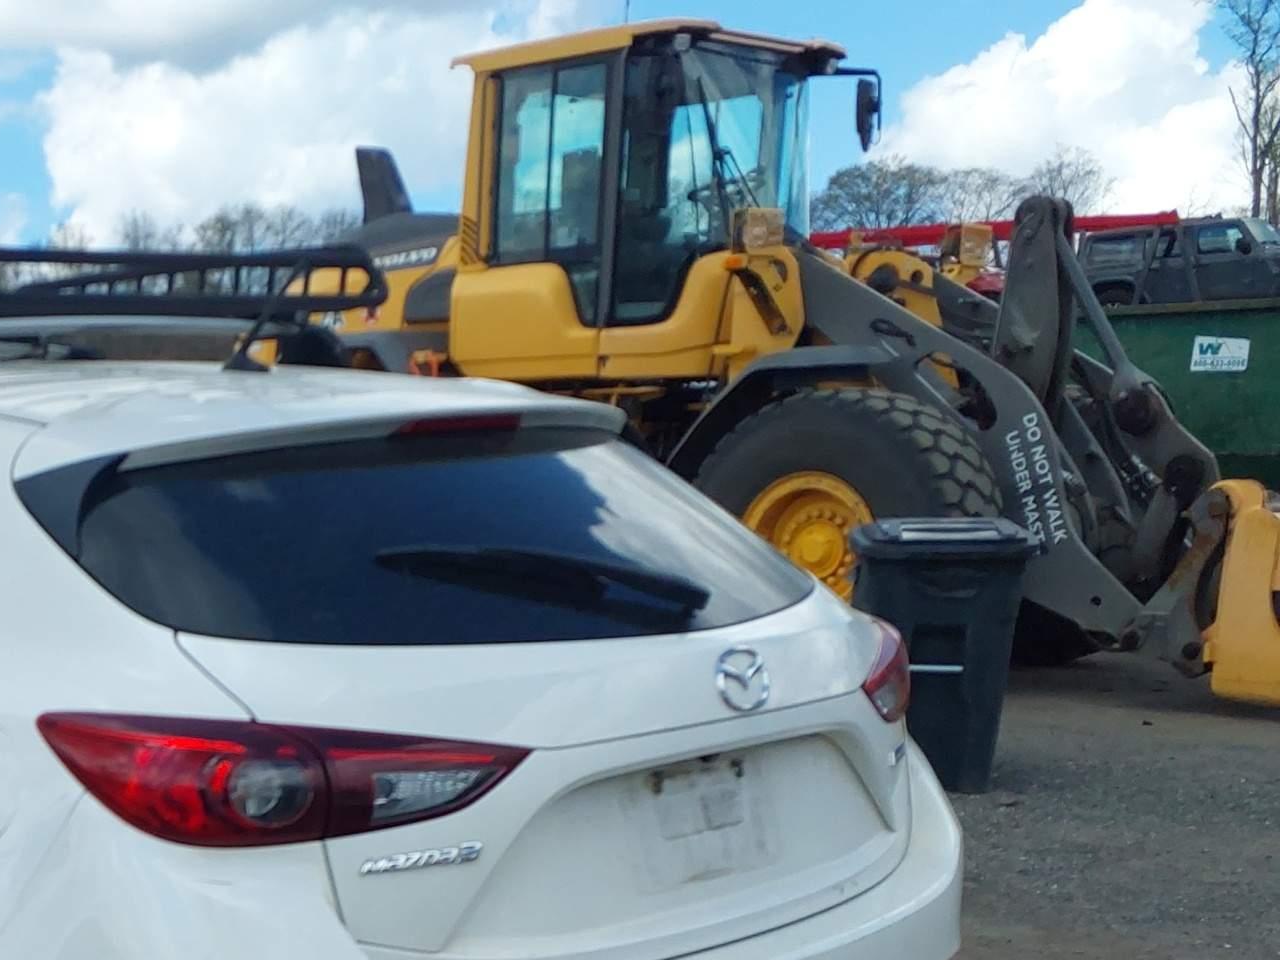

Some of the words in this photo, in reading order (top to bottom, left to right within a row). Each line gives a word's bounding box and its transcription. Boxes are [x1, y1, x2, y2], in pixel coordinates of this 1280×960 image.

[1023, 412, 1041, 442] DO
[1005, 430, 1032, 493] UNDER
[1022, 495, 1046, 543] MAST
[1030, 445, 1053, 484] NOT
[1043, 488, 1068, 544] WALK
